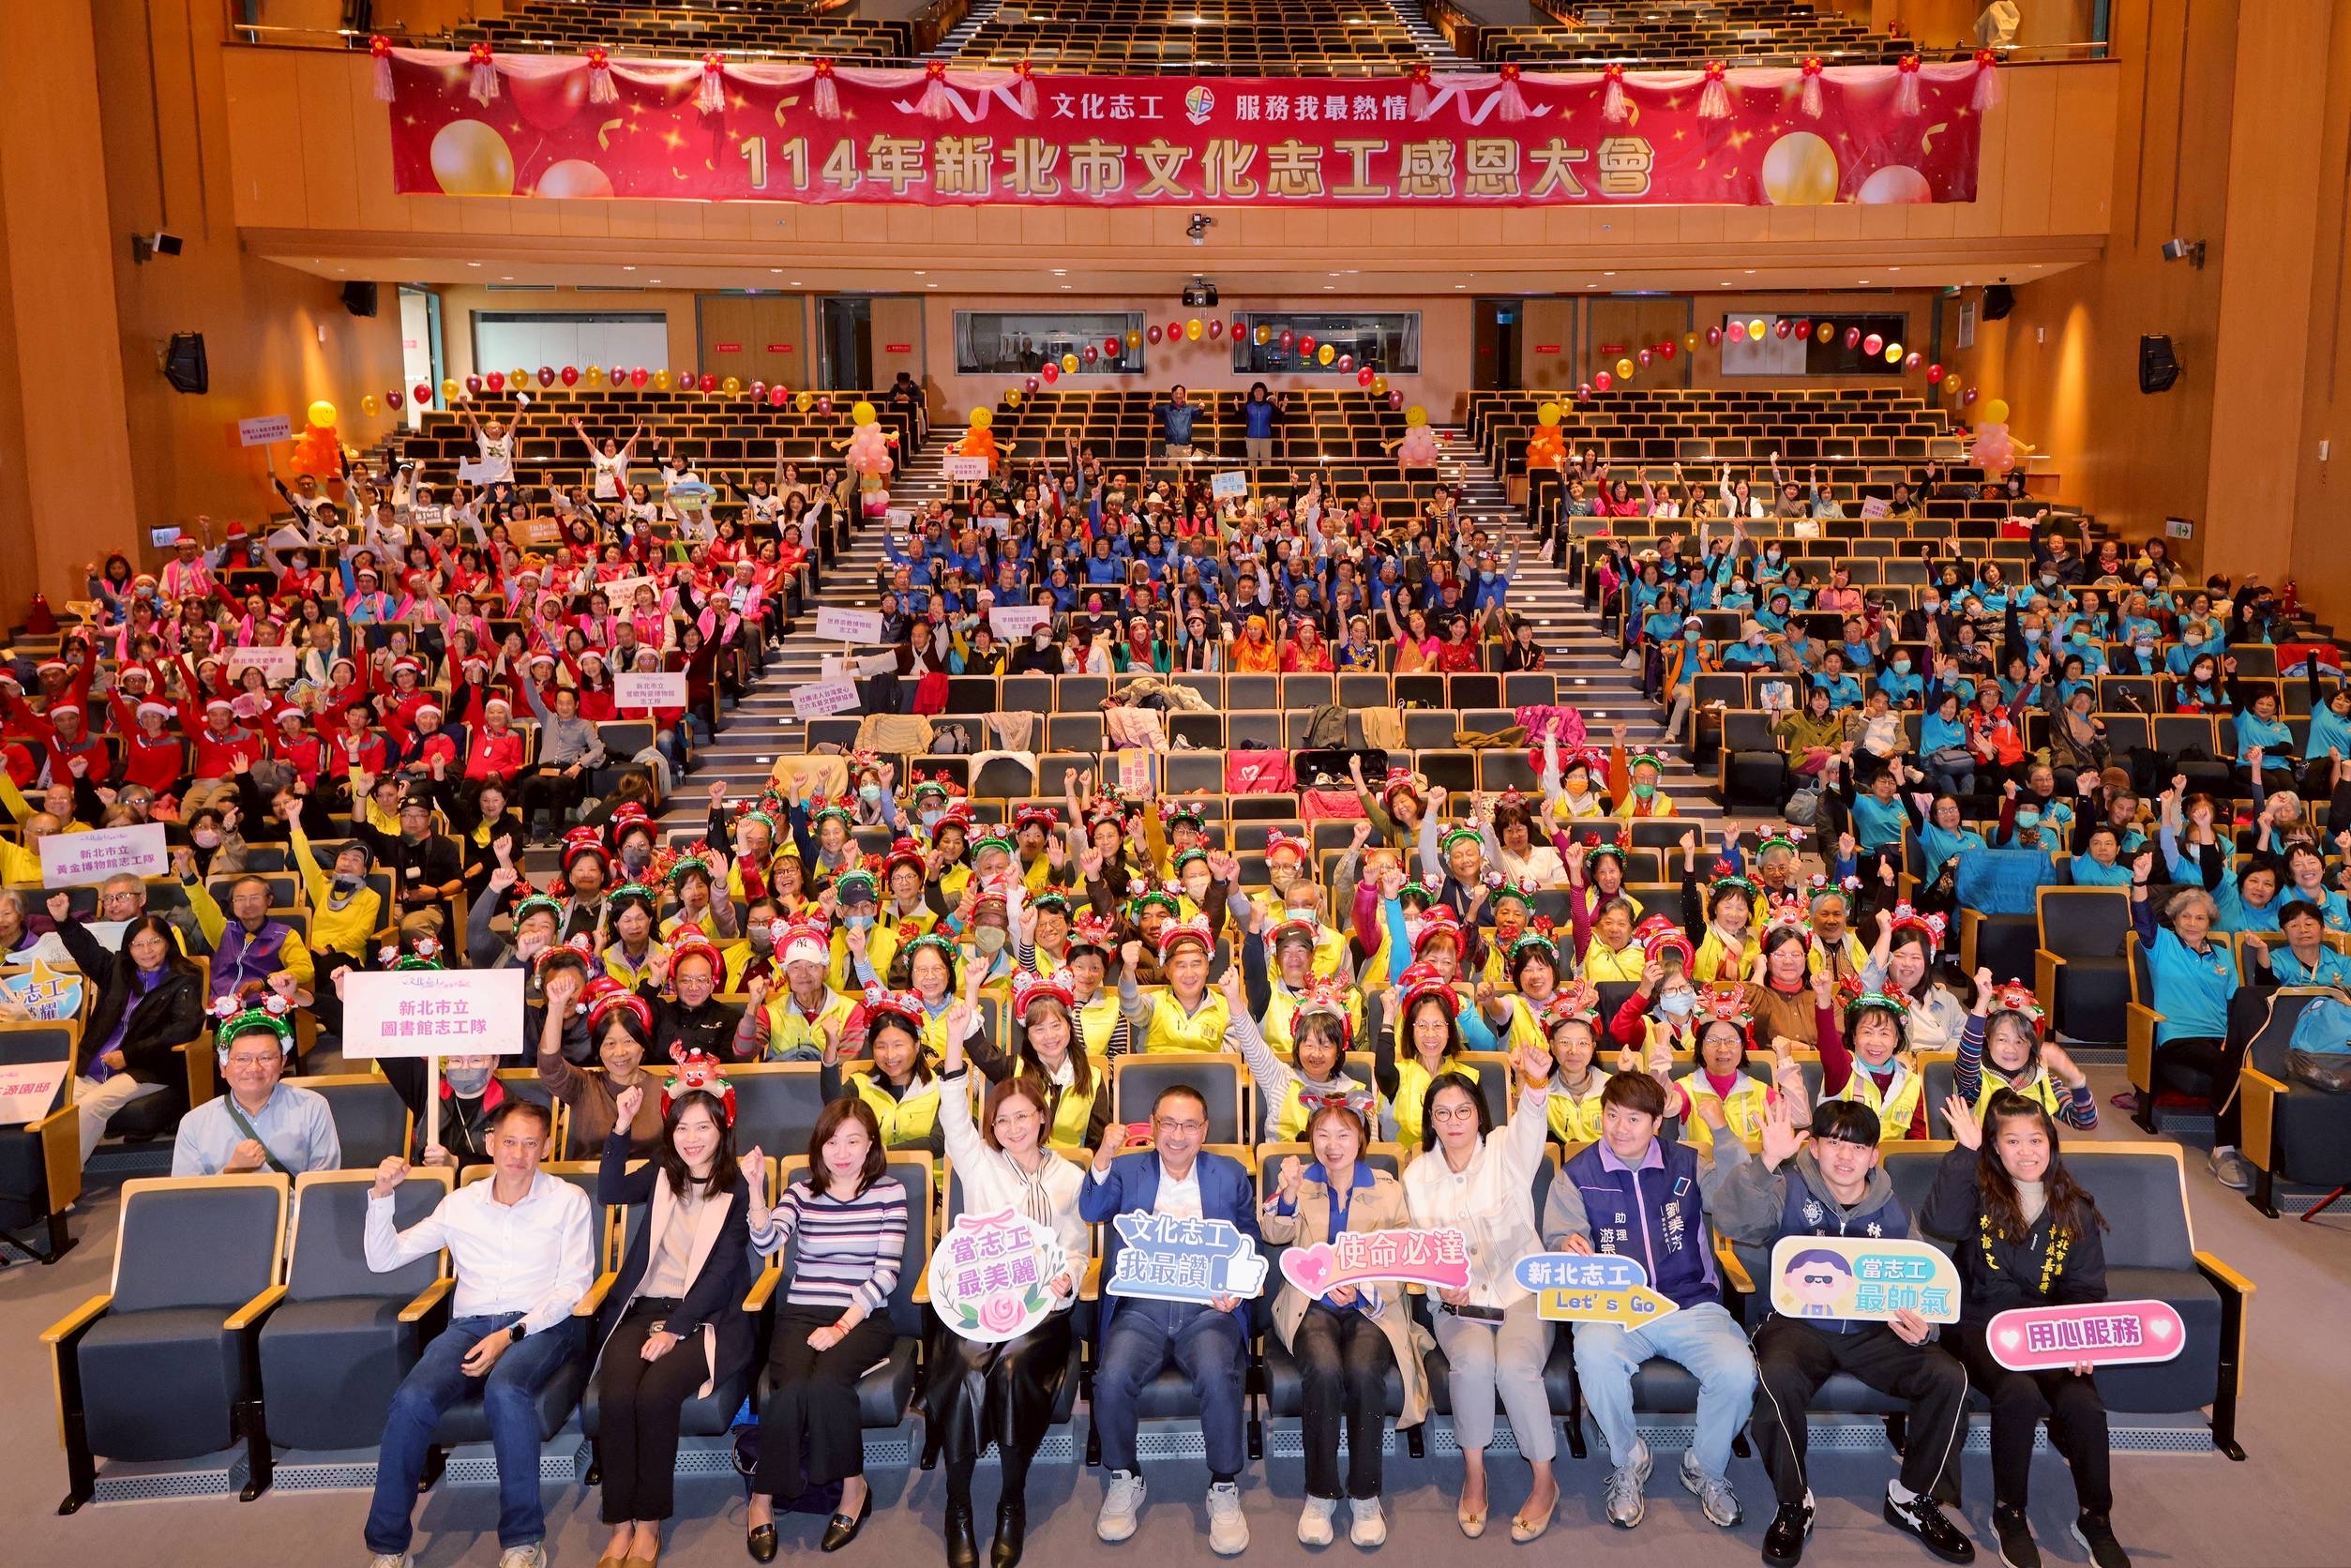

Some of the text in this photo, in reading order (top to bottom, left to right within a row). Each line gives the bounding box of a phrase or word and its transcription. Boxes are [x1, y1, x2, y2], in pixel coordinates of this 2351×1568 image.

[1050, 93, 1408, 121] 文化志工 服務我最熱情
[741, 135, 1654, 198] 114年新北市文化志工感恩大會
[827, 618, 872, 629] 世界宗教博物館
[839, 626, 859, 635] 志工隊
[799, 686, 850, 703] 社團法人台灣愛心
[819, 703, 838, 714] 志工隊
[56, 853, 156, 875] 黃金博物館志工隊
[80, 845, 130, 860] 新北市立
[399, 1000, 469, 1016] 新北市立
[381, 1018, 487, 1036] 圖書館志工隊
[0, 1082, 51, 1095] 源園邸
[1128, 1214, 1229, 1248] 文化志工
[1614, 1212, 1628, 1242] 助理
[950, 1225, 1032, 1265] 當志工
[1336, 1230, 1467, 1270] 使命必達
[957, 1255, 1038, 1297] 最美麗
[1120, 1250, 1208, 1289] 我最讚
[1528, 1261, 1632, 1286] 新北志工
[1861, 1258, 1927, 1279] 當志工
[1630, 1295, 1656, 1313] Go
[1855, 1283, 1952, 1316] 最帥氣
[2027, 1317, 2141, 1351] 用心服務
